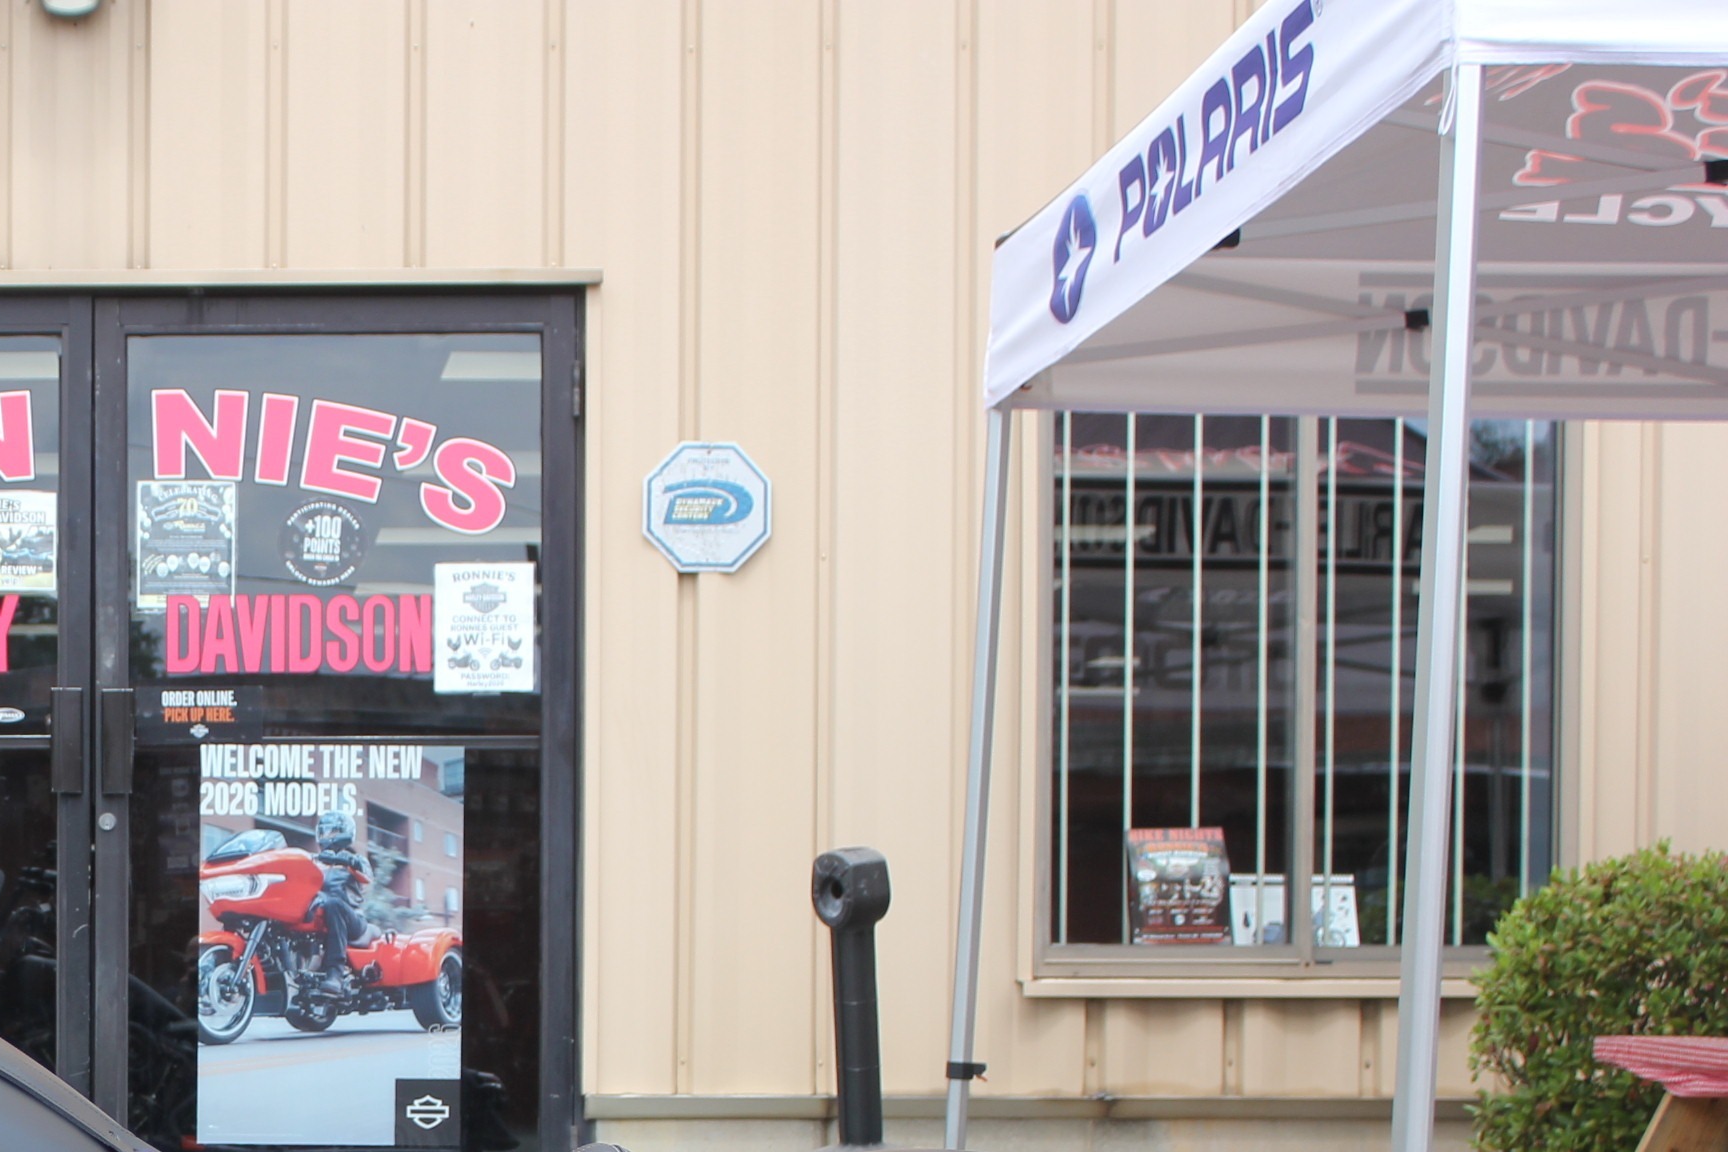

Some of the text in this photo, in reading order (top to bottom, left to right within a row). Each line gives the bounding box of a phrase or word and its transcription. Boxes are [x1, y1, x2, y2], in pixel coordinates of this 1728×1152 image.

[1113, 0, 1315, 265] POLARIS
[151, 388, 516, 535] NIE'S
[304, 515, 342, 539] +100
[303, 537, 341, 555] POINTS
[452, 570, 516, 583] RONNIE'S
[452, 615, 517, 623] CONNECT TO
[490, 624, 518, 632] GUEST
[165, 594, 433, 674] DAVIDSON
[464, 632, 505, 646] Wi-Fi
[161, 690, 237, 707] ORDER ONLINE.
[164, 707, 235, 722] PICK UP HERE.
[200, 744, 423, 779] WELCOME THE NEW
[200, 782, 364, 817] 2026 MODELS.
